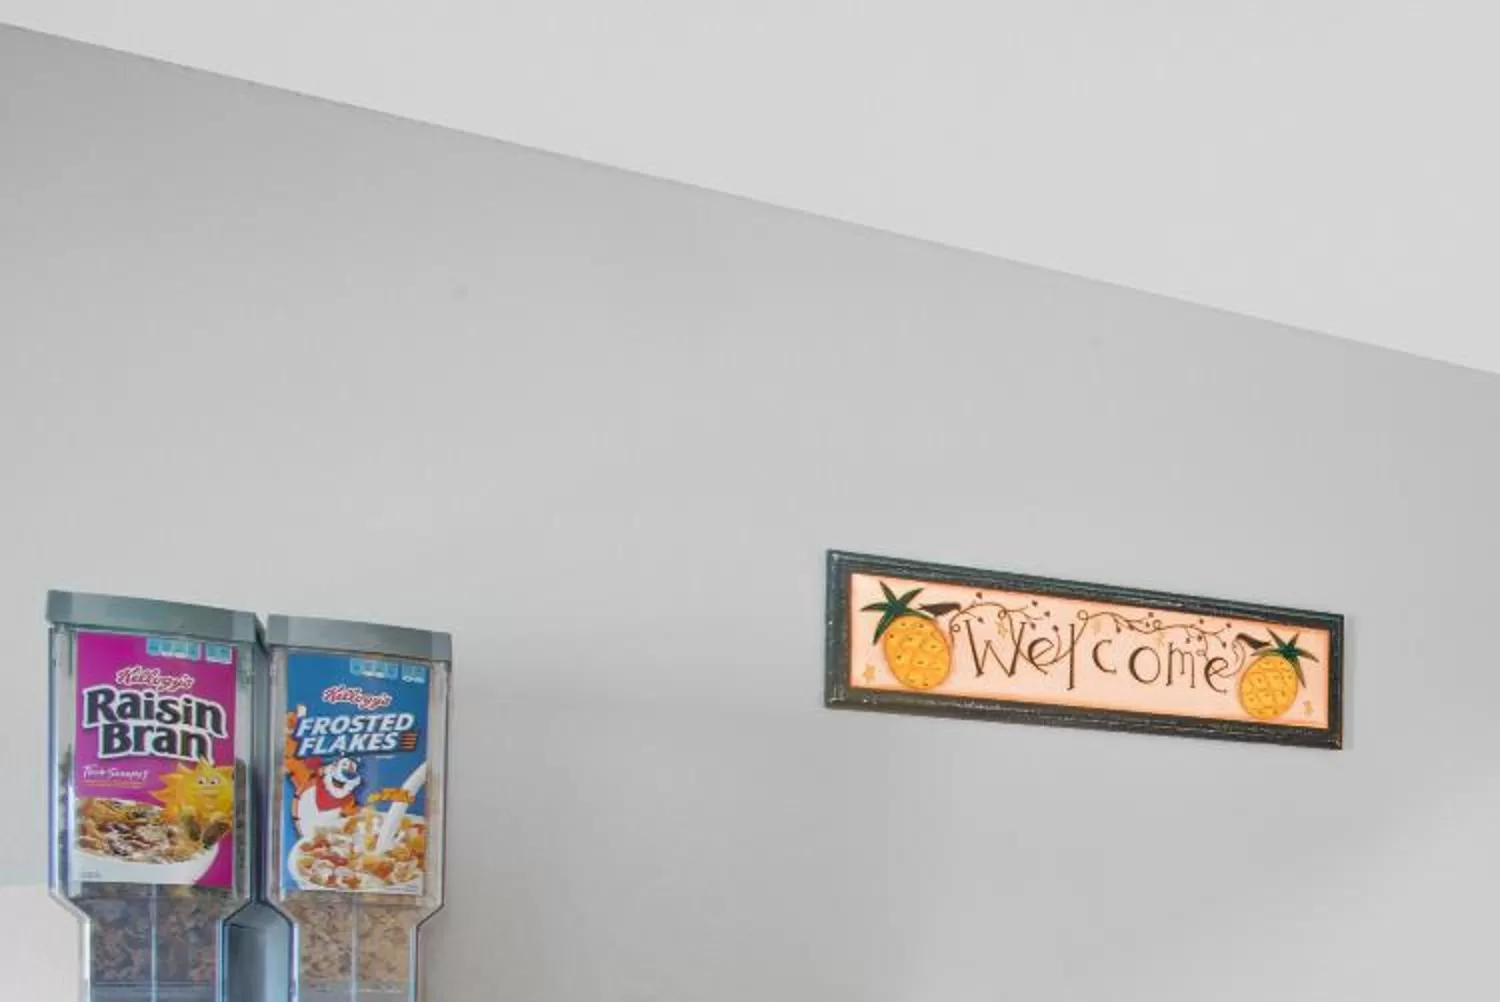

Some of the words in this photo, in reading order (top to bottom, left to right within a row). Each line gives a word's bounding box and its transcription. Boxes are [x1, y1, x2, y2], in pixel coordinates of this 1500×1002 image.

[963, 617, 1231, 693] Welcome
[115, 665, 196, 692] Kellogg's
[321, 683, 393, 711] Kellogg's
[83, 685, 227, 738] Raisin
[296, 713, 415, 737] FROSTED
[99, 722, 213, 765] Bran
[297, 731, 399, 757] FLAKES
